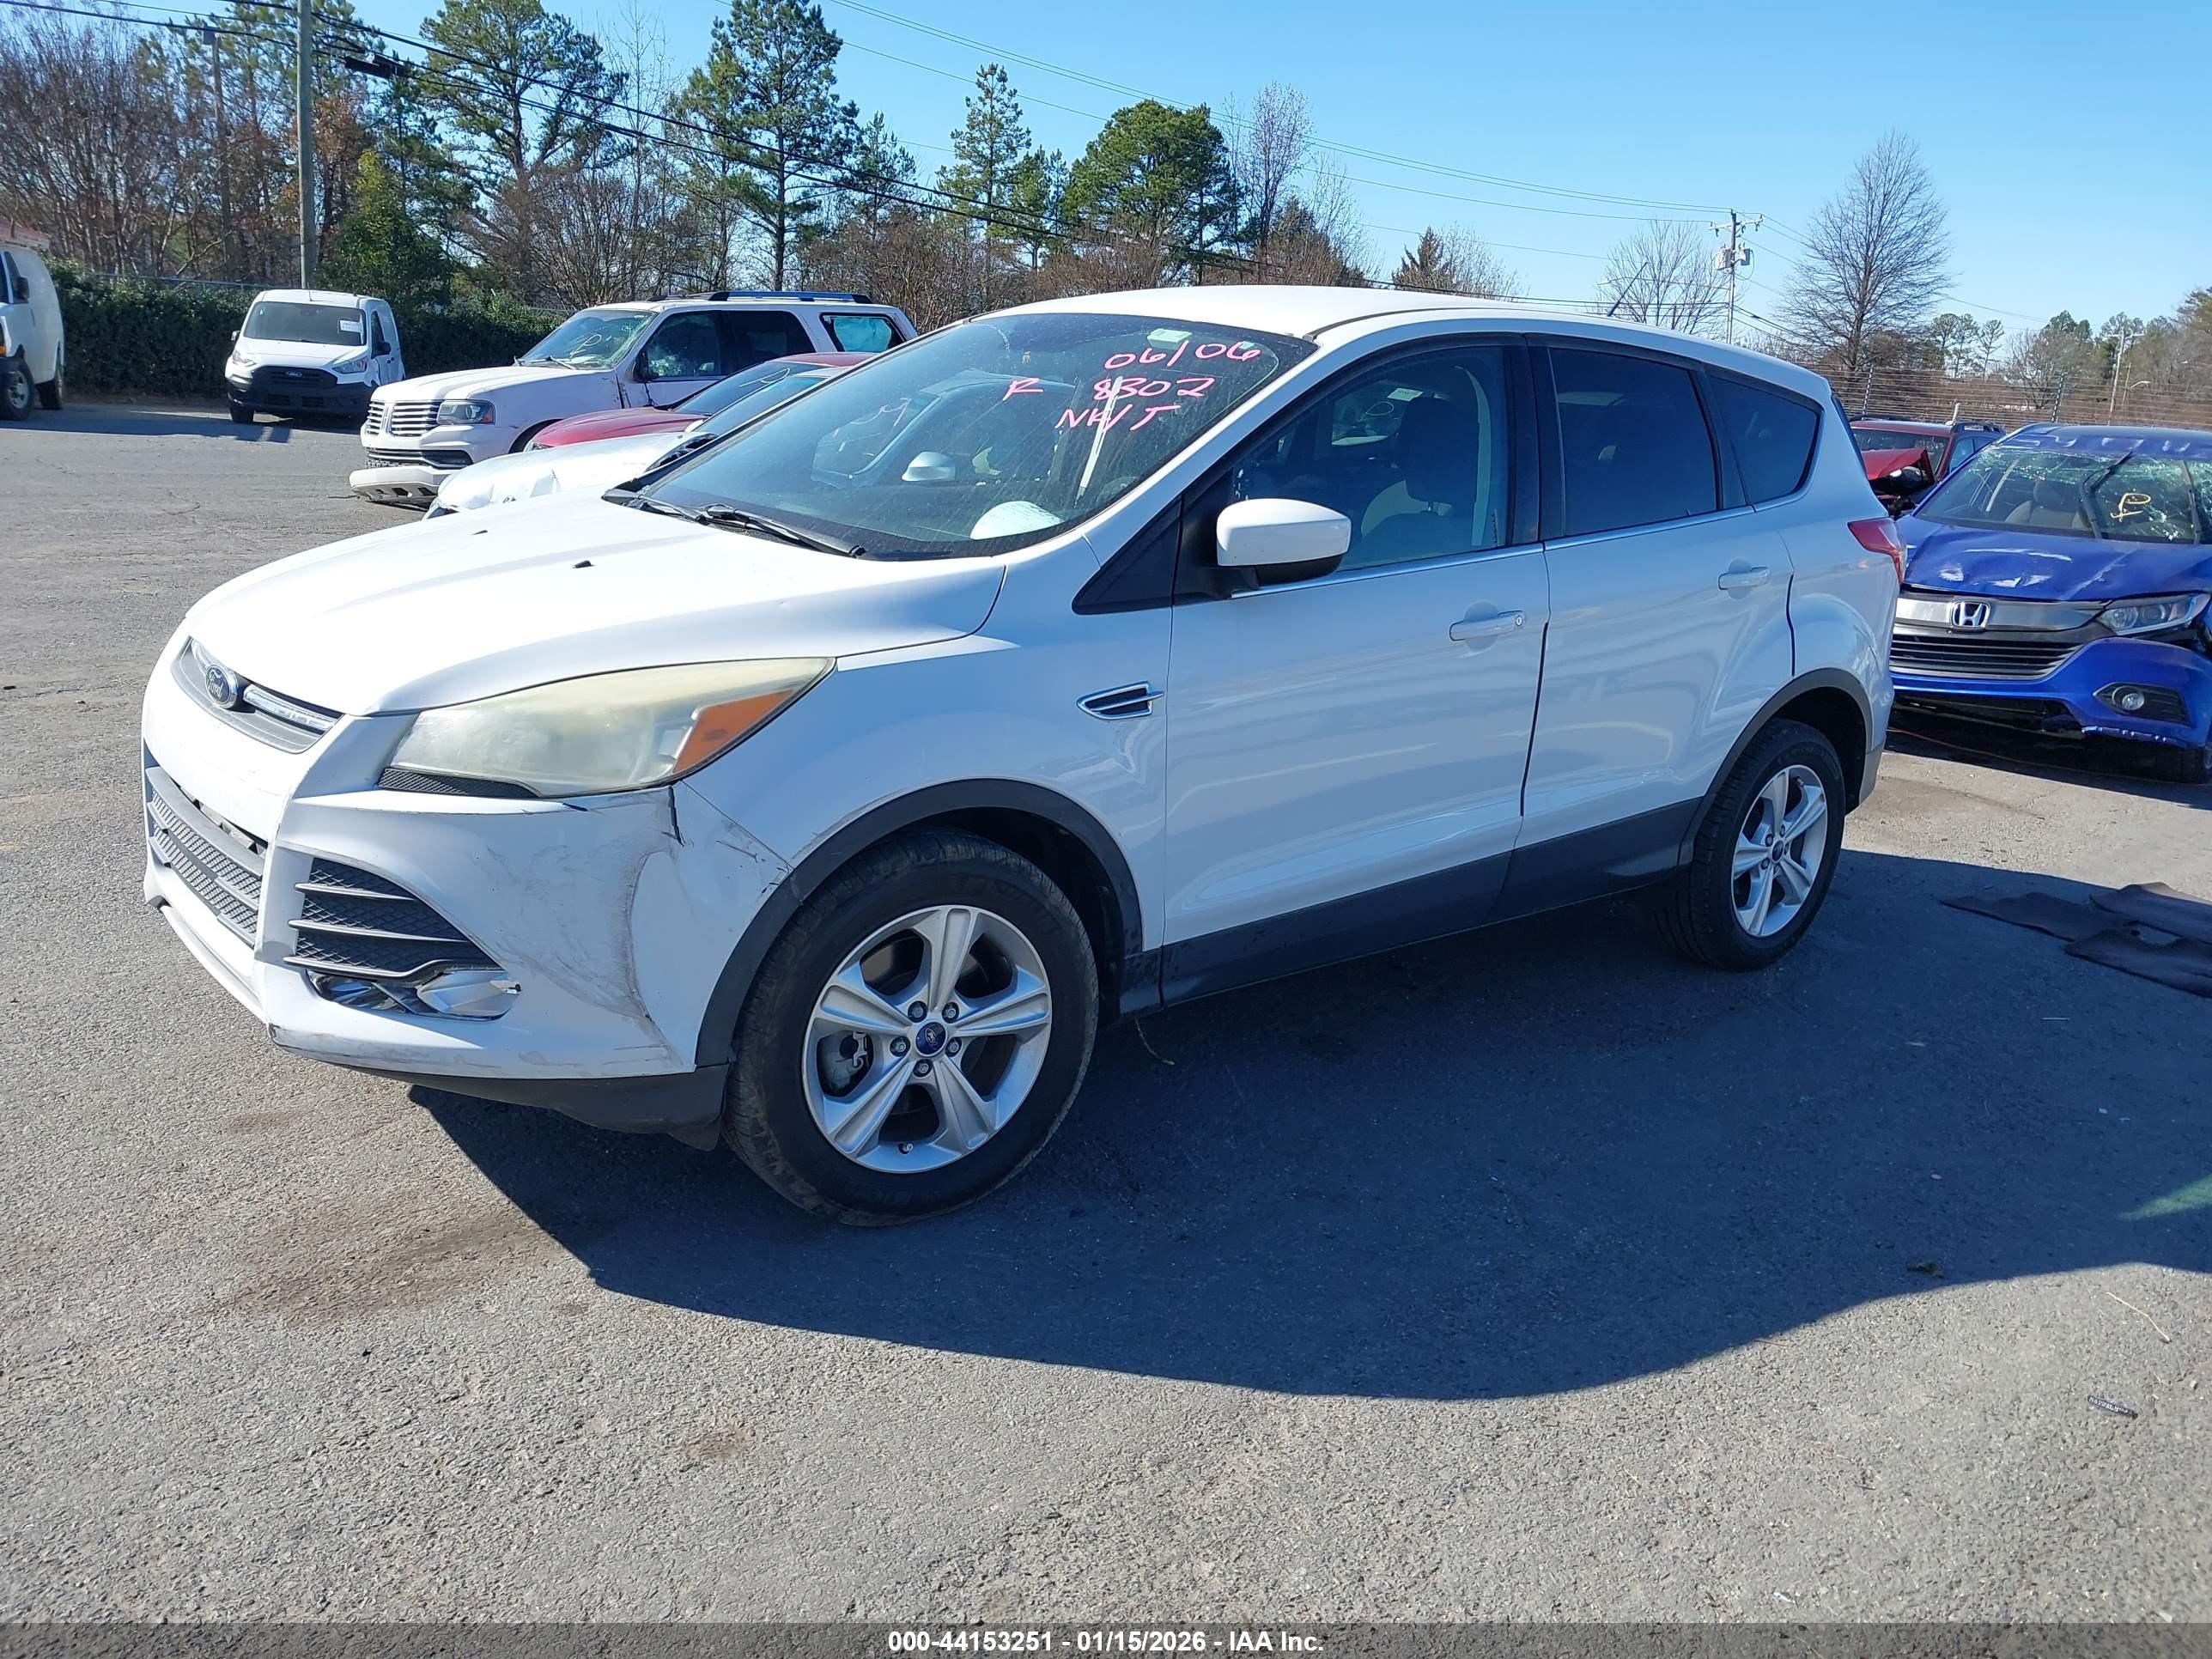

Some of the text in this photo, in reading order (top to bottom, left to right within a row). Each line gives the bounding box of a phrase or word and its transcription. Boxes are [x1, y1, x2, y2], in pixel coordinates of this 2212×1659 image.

[1104, 340, 1261, 369] 06/06
[1094, 378, 1215, 400] 8302
[207, 669, 224, 699] Ford
